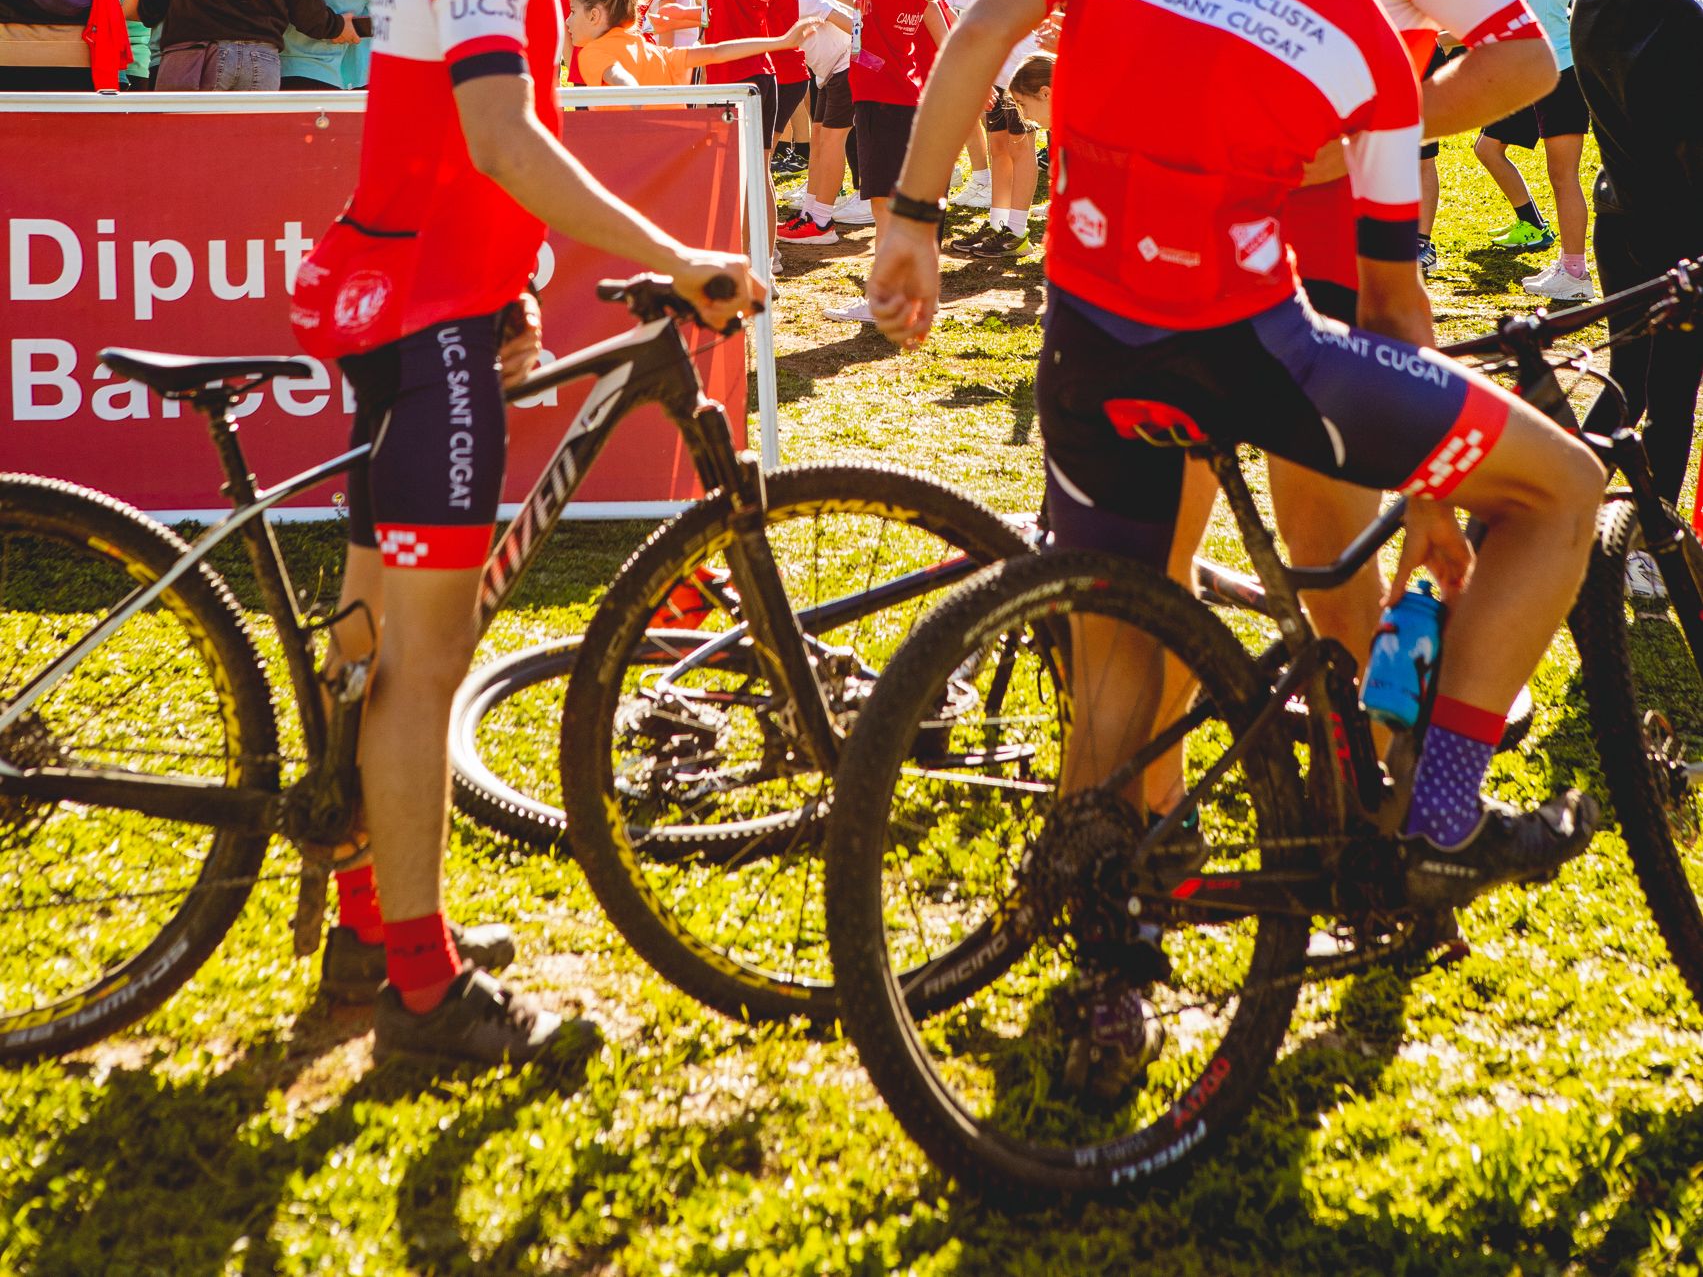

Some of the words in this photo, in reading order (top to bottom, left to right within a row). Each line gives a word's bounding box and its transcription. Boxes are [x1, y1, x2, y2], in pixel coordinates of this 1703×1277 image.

[1226, 11, 1307, 60] CUGAT
[1375, 344, 1450, 389] CUGAT
[446, 369, 473, 428] SANT
[449, 431, 474, 511] CUGAT
